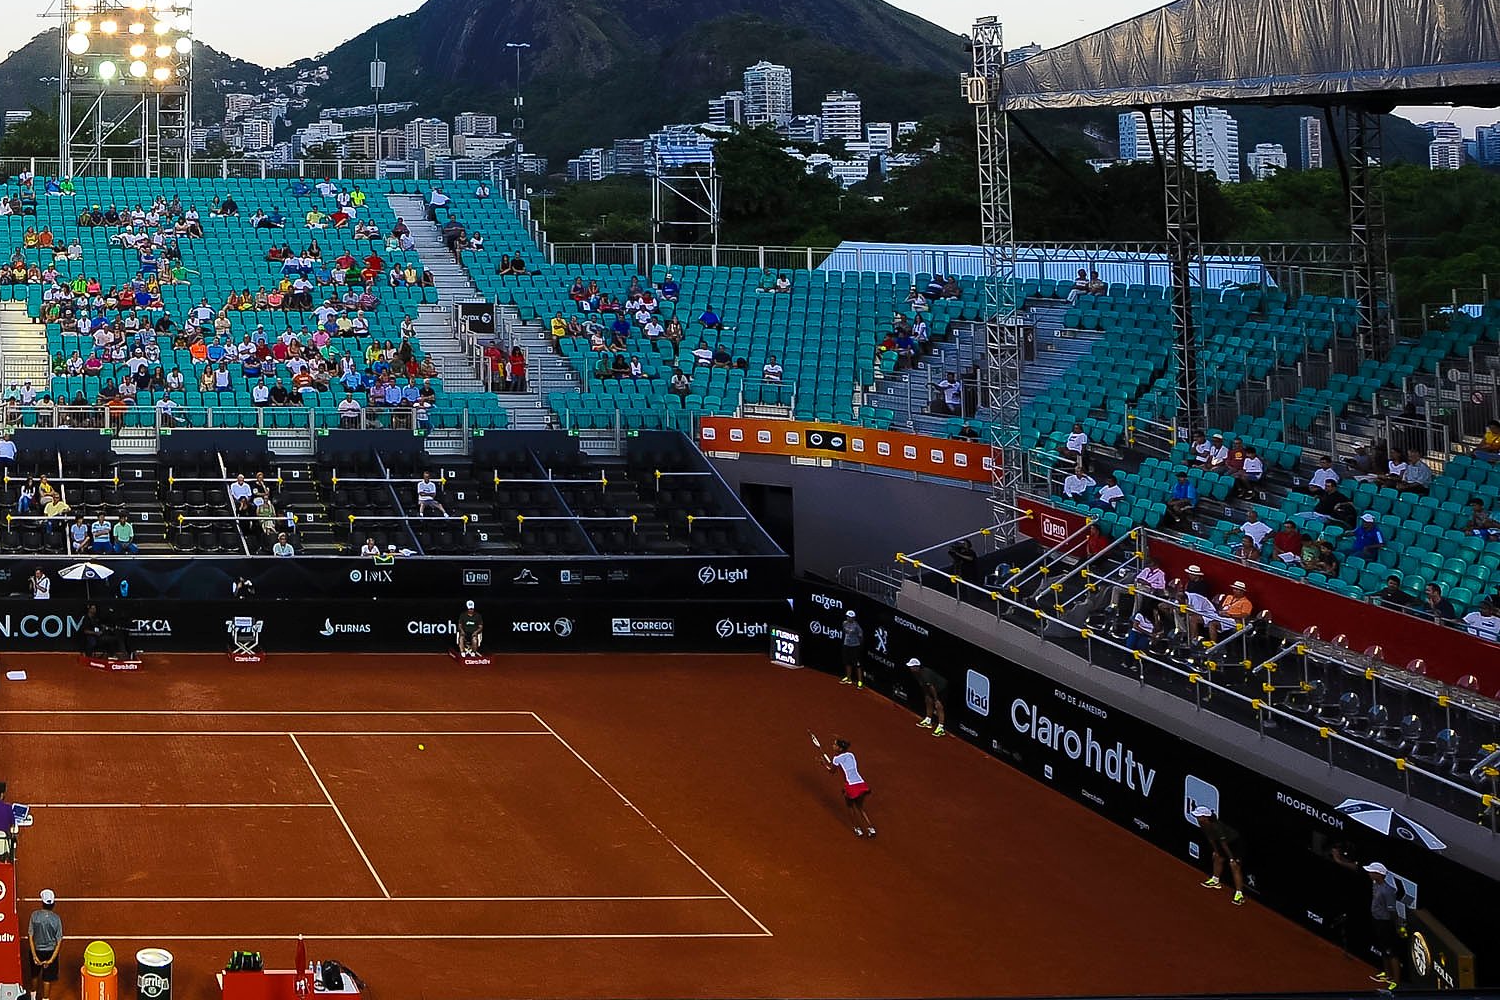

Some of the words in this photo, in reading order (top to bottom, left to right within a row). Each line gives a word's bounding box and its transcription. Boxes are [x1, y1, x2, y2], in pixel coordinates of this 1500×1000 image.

[717, 567, 748, 583] Light
[335, 624, 371, 634] FURNAS
[407, 620, 457, 634] Claroh
[512, 621, 550, 633] xerox
[736, 621, 768, 638] Light
[894, 615, 929, 637] RIOOPEN.COM
[775, 639, 795, 655] 129
[967, 686, 988, 711] Itaú
[1054, 688, 1067, 701] RIO
[1067, 694, 1077, 706] DE
[1078, 699, 1108, 719] JANEIRO
[1011, 698, 1156, 798] Clarohdtv
[1276, 791, 1344, 831] RIOOPEN.COM
[89, 960, 114, 968] HEAD
[1433, 960, 1454, 989] ROLEX
